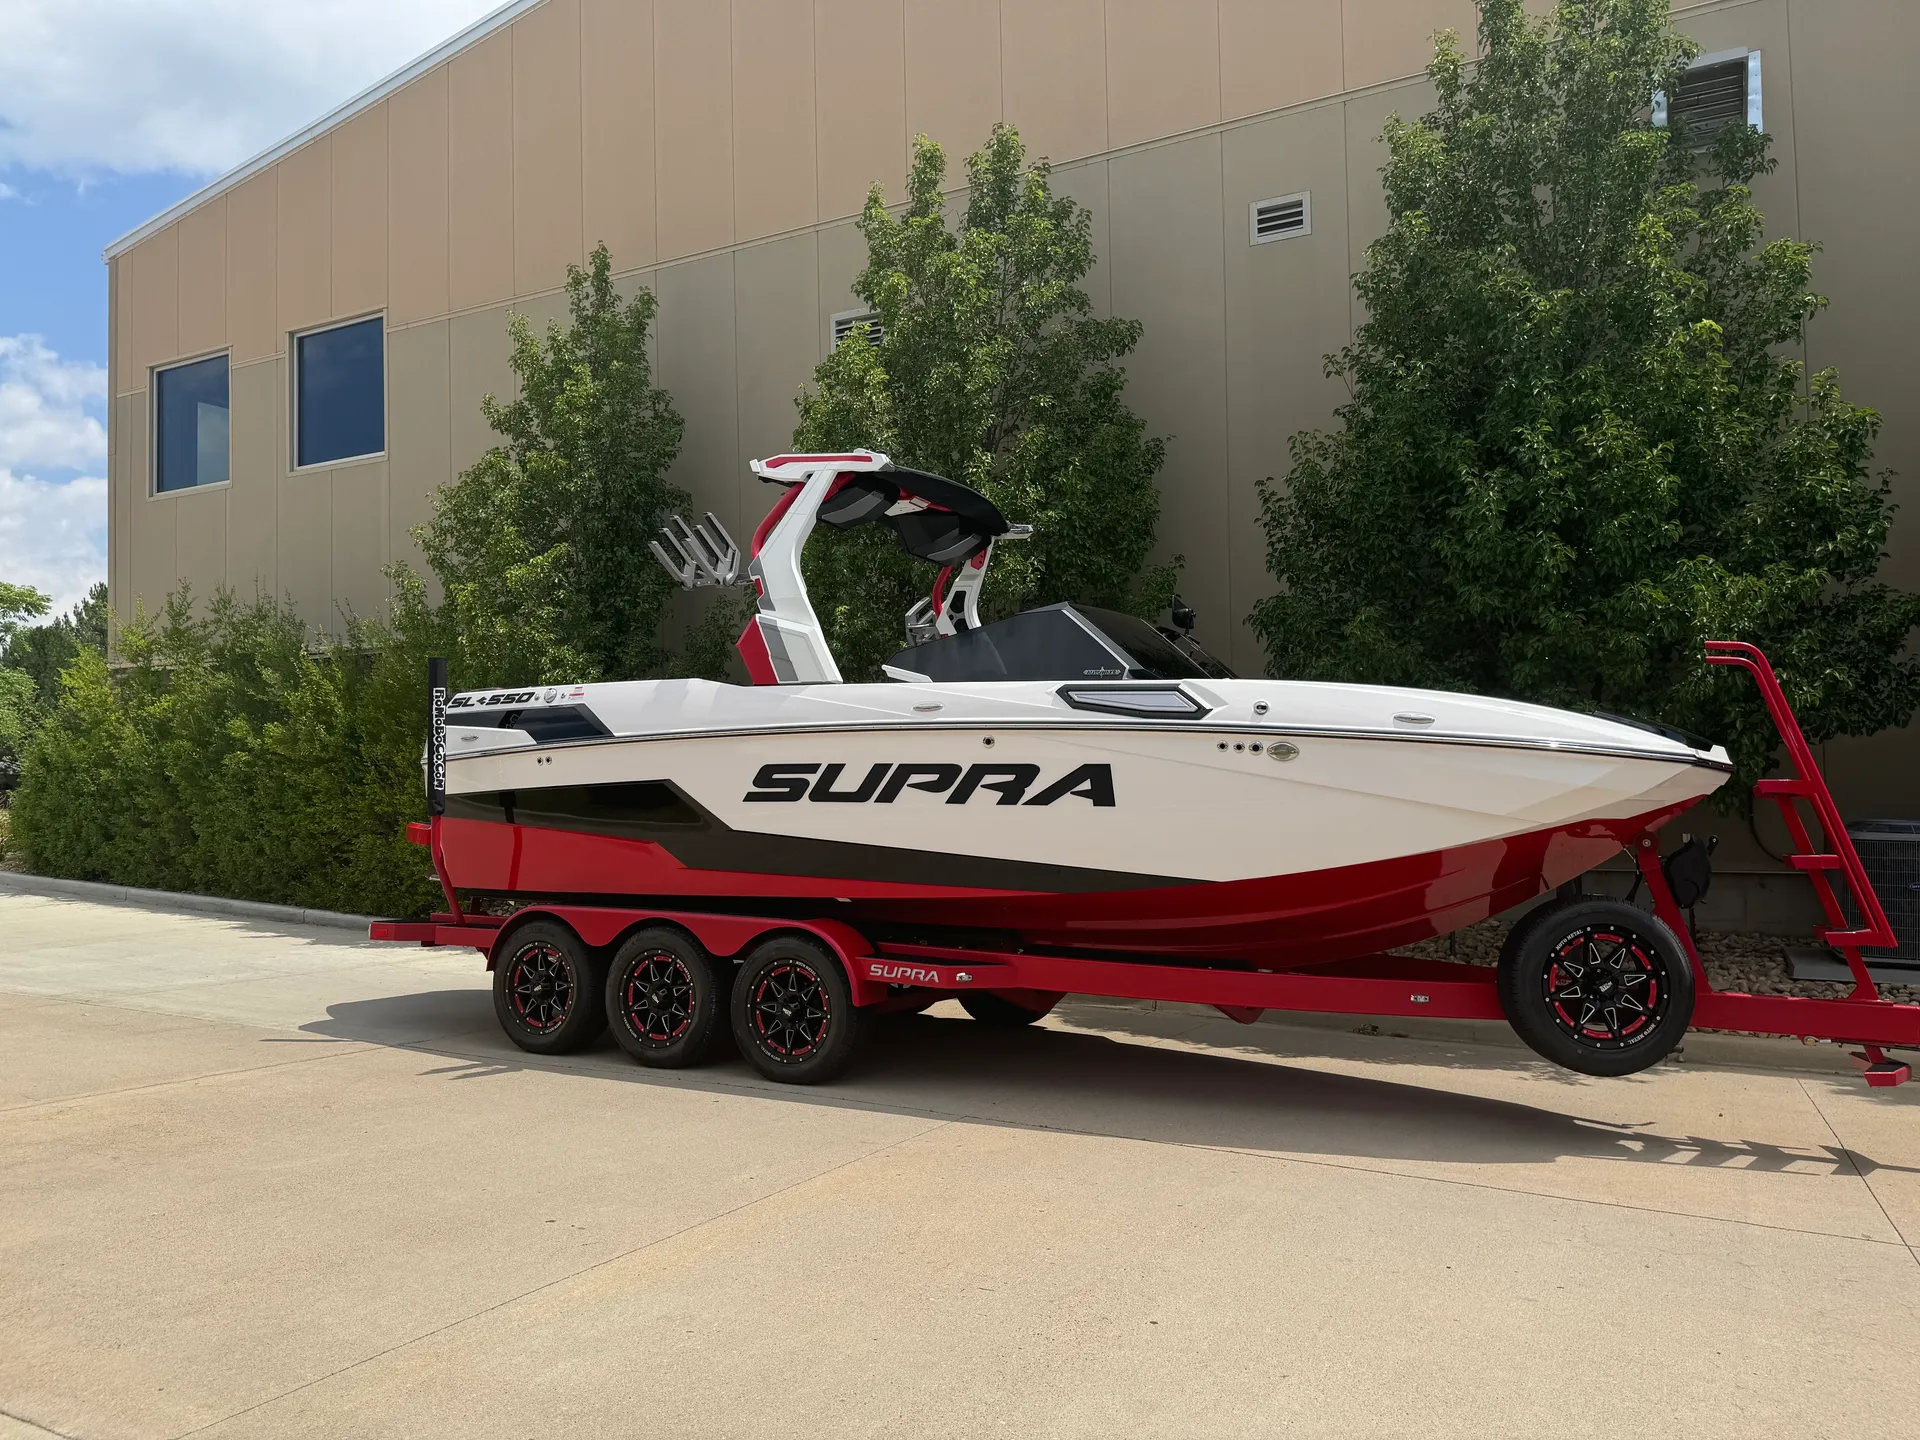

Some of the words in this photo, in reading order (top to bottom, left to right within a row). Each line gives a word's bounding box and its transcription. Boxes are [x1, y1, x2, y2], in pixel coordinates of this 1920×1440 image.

[742, 763, 1116, 807] SUPRA
[1566, 929, 1584, 941] METAL
[869, 964, 940, 983] SUPRA
